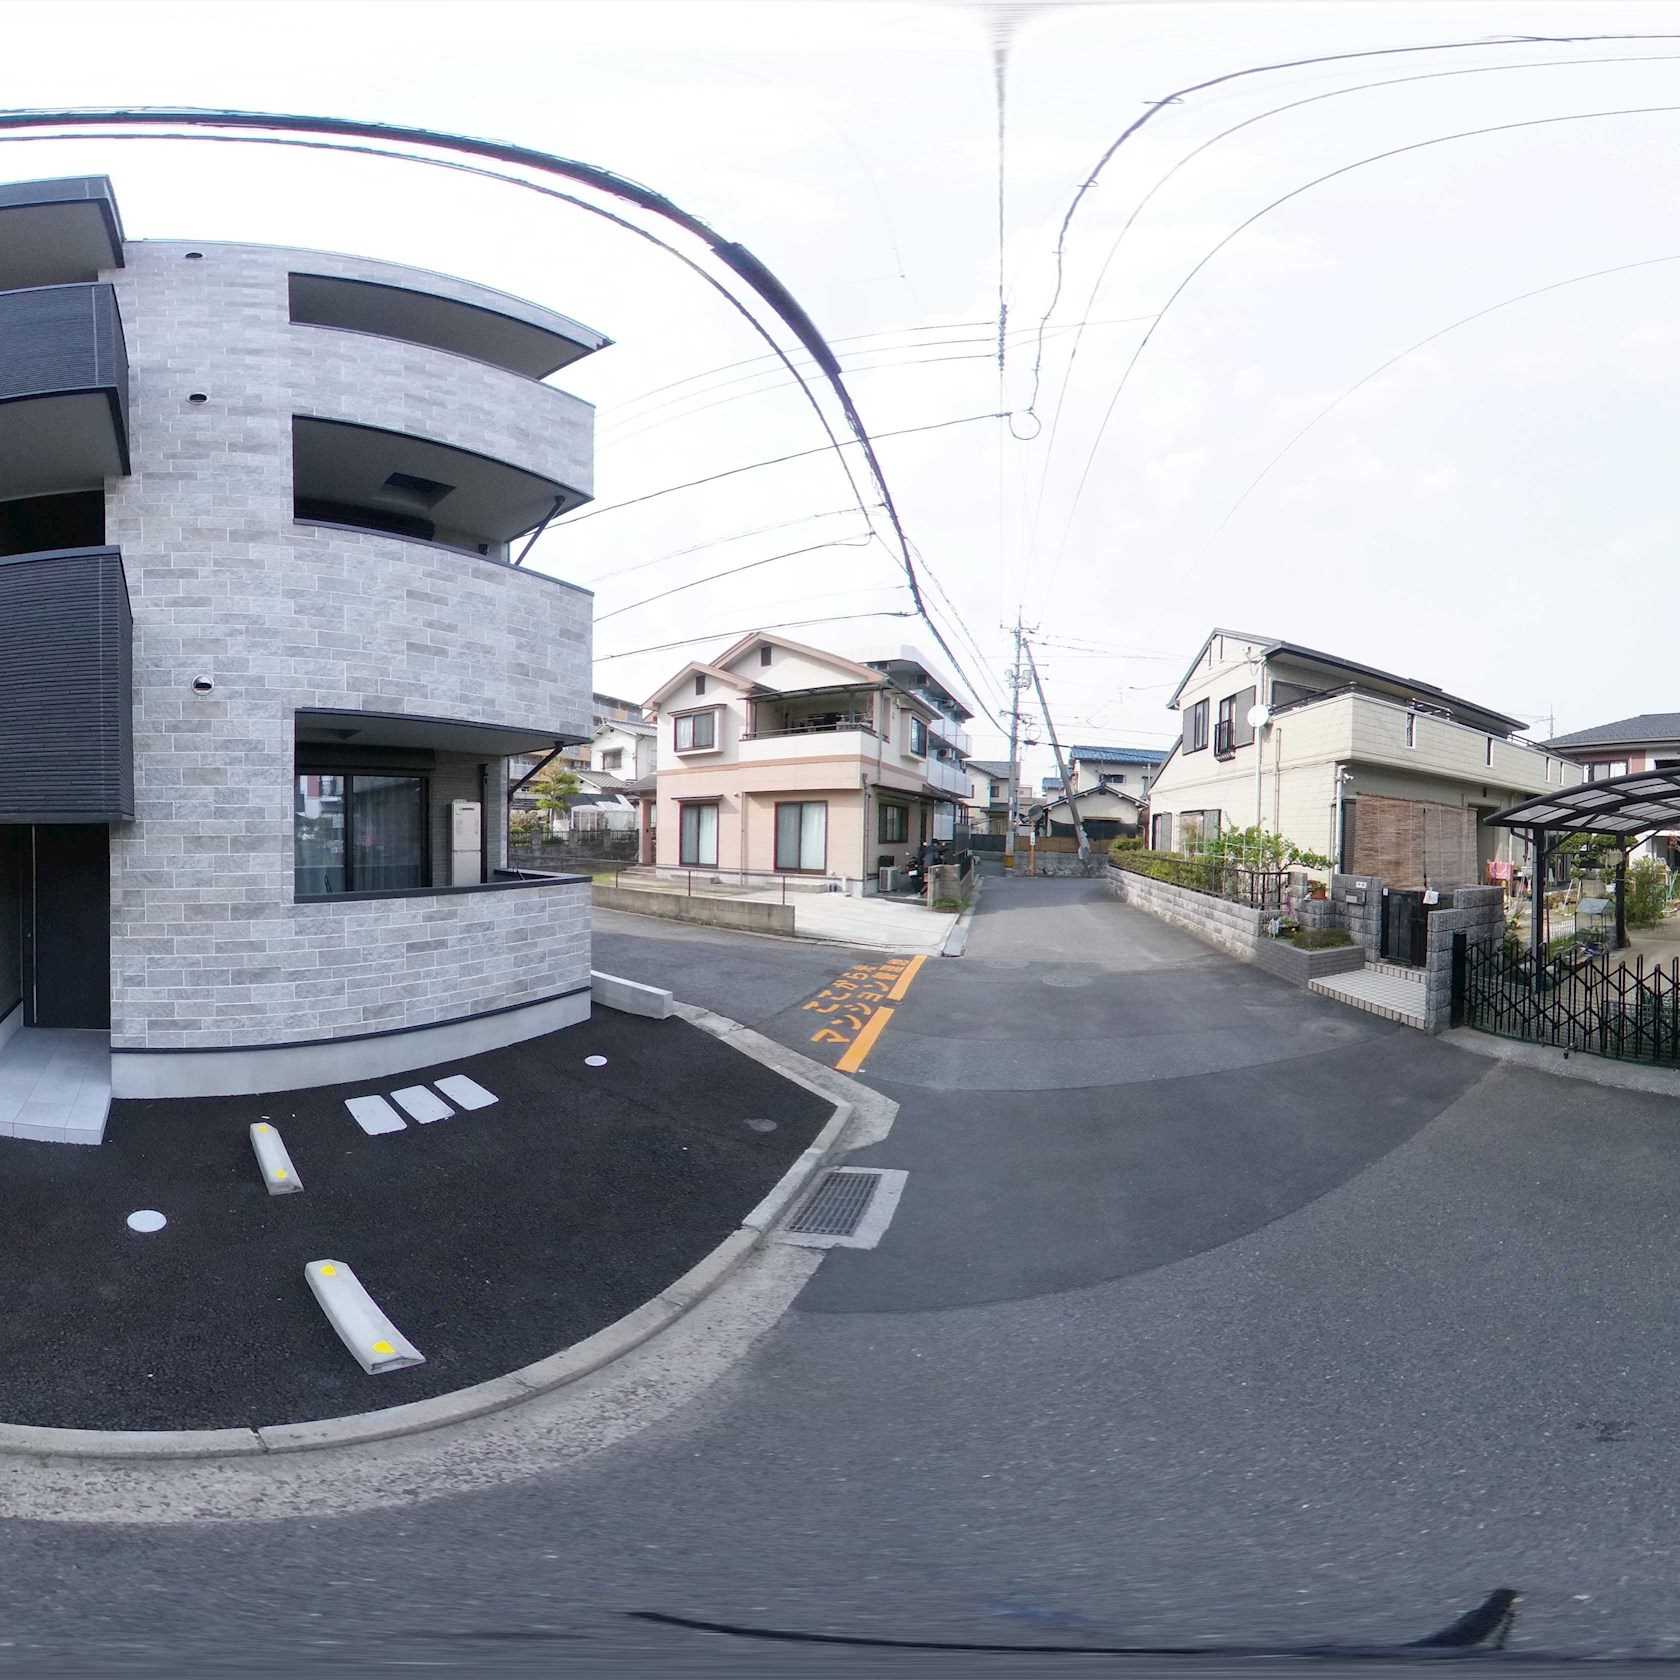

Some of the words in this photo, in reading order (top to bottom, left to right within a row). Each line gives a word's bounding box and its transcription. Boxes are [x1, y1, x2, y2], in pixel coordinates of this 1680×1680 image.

[809, 959, 911, 1042] マンション
